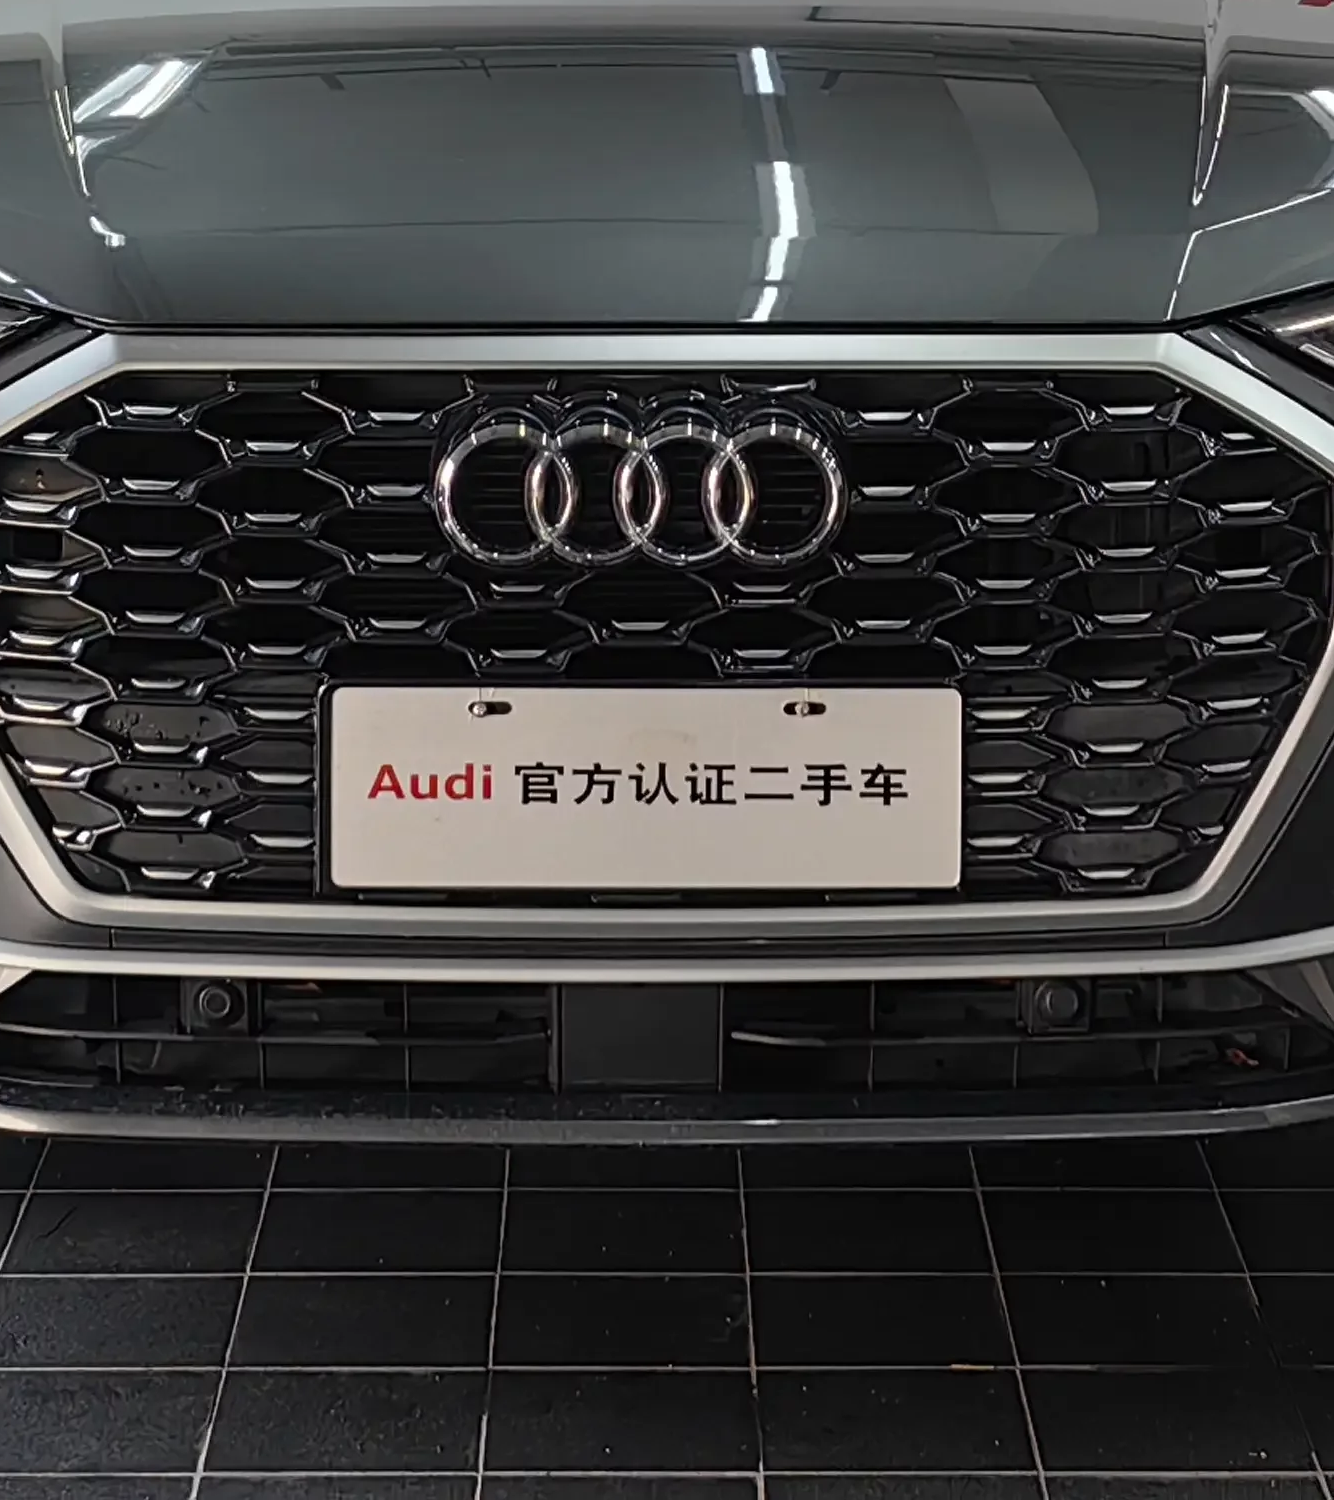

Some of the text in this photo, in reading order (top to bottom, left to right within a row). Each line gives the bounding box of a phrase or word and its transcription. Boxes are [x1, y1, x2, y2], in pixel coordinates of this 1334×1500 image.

[367, 761, 910, 807] Audi 官方认证二手车
